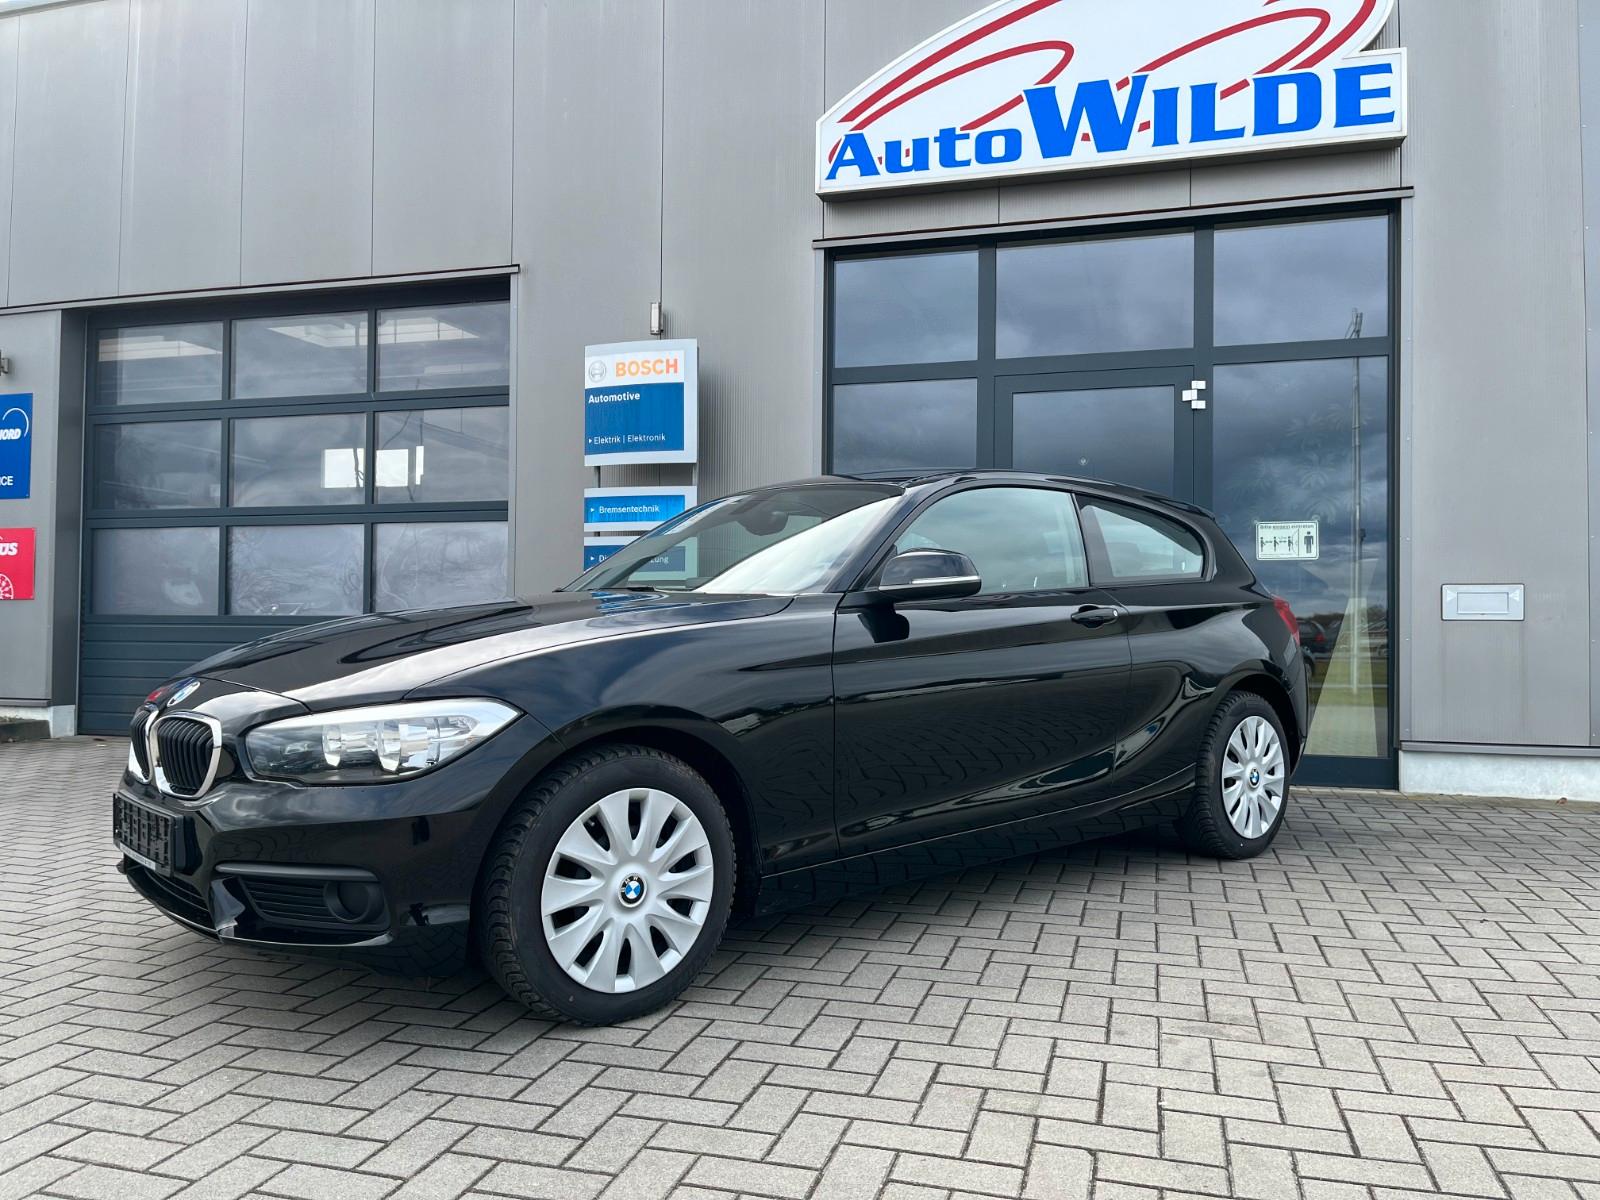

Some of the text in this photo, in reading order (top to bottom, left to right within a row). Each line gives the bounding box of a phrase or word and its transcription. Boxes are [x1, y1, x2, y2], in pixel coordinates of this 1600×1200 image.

[615, 358, 679, 377] BOSCH
[588, 391, 641, 404] Automotive
[593, 432, 666, 445] Elektrik Elektronik
[598, 504, 661, 514] Bremsentechnik
